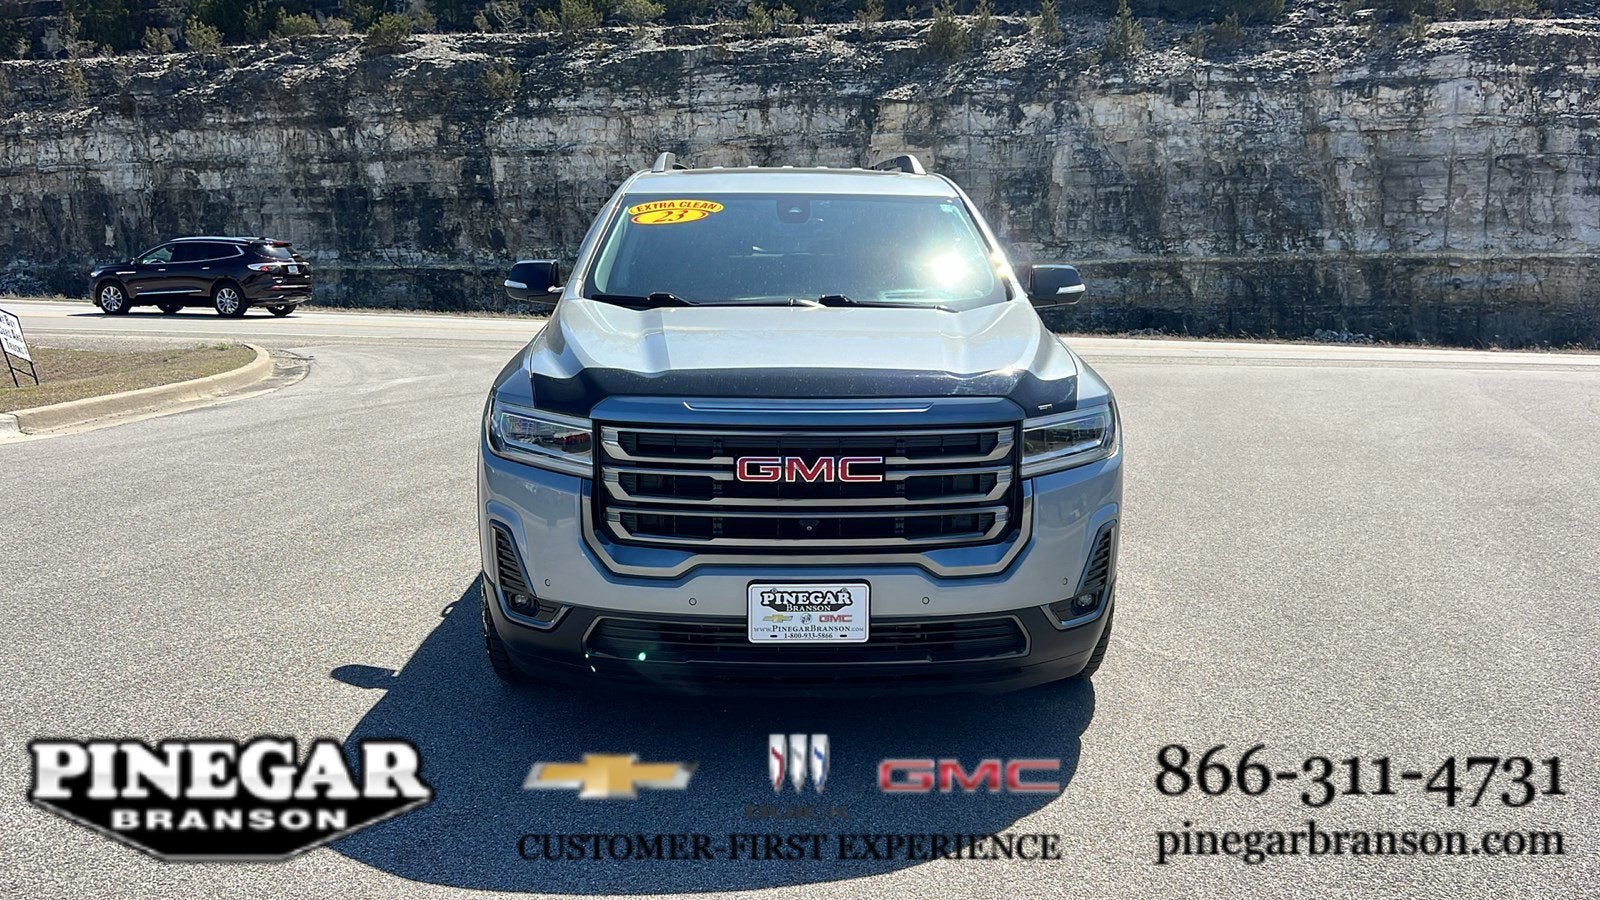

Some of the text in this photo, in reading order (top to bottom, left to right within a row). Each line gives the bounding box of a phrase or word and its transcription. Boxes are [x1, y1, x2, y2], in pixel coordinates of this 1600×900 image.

[637, 201, 718, 212] EXTRA CLEAN
[653, 209, 689, 223] 23
[736, 456, 883, 482] GMC
[761, 591, 852, 605] PINEGAR
[786, 604, 831, 612] BRANSON
[819, 614, 852, 623] GMC
